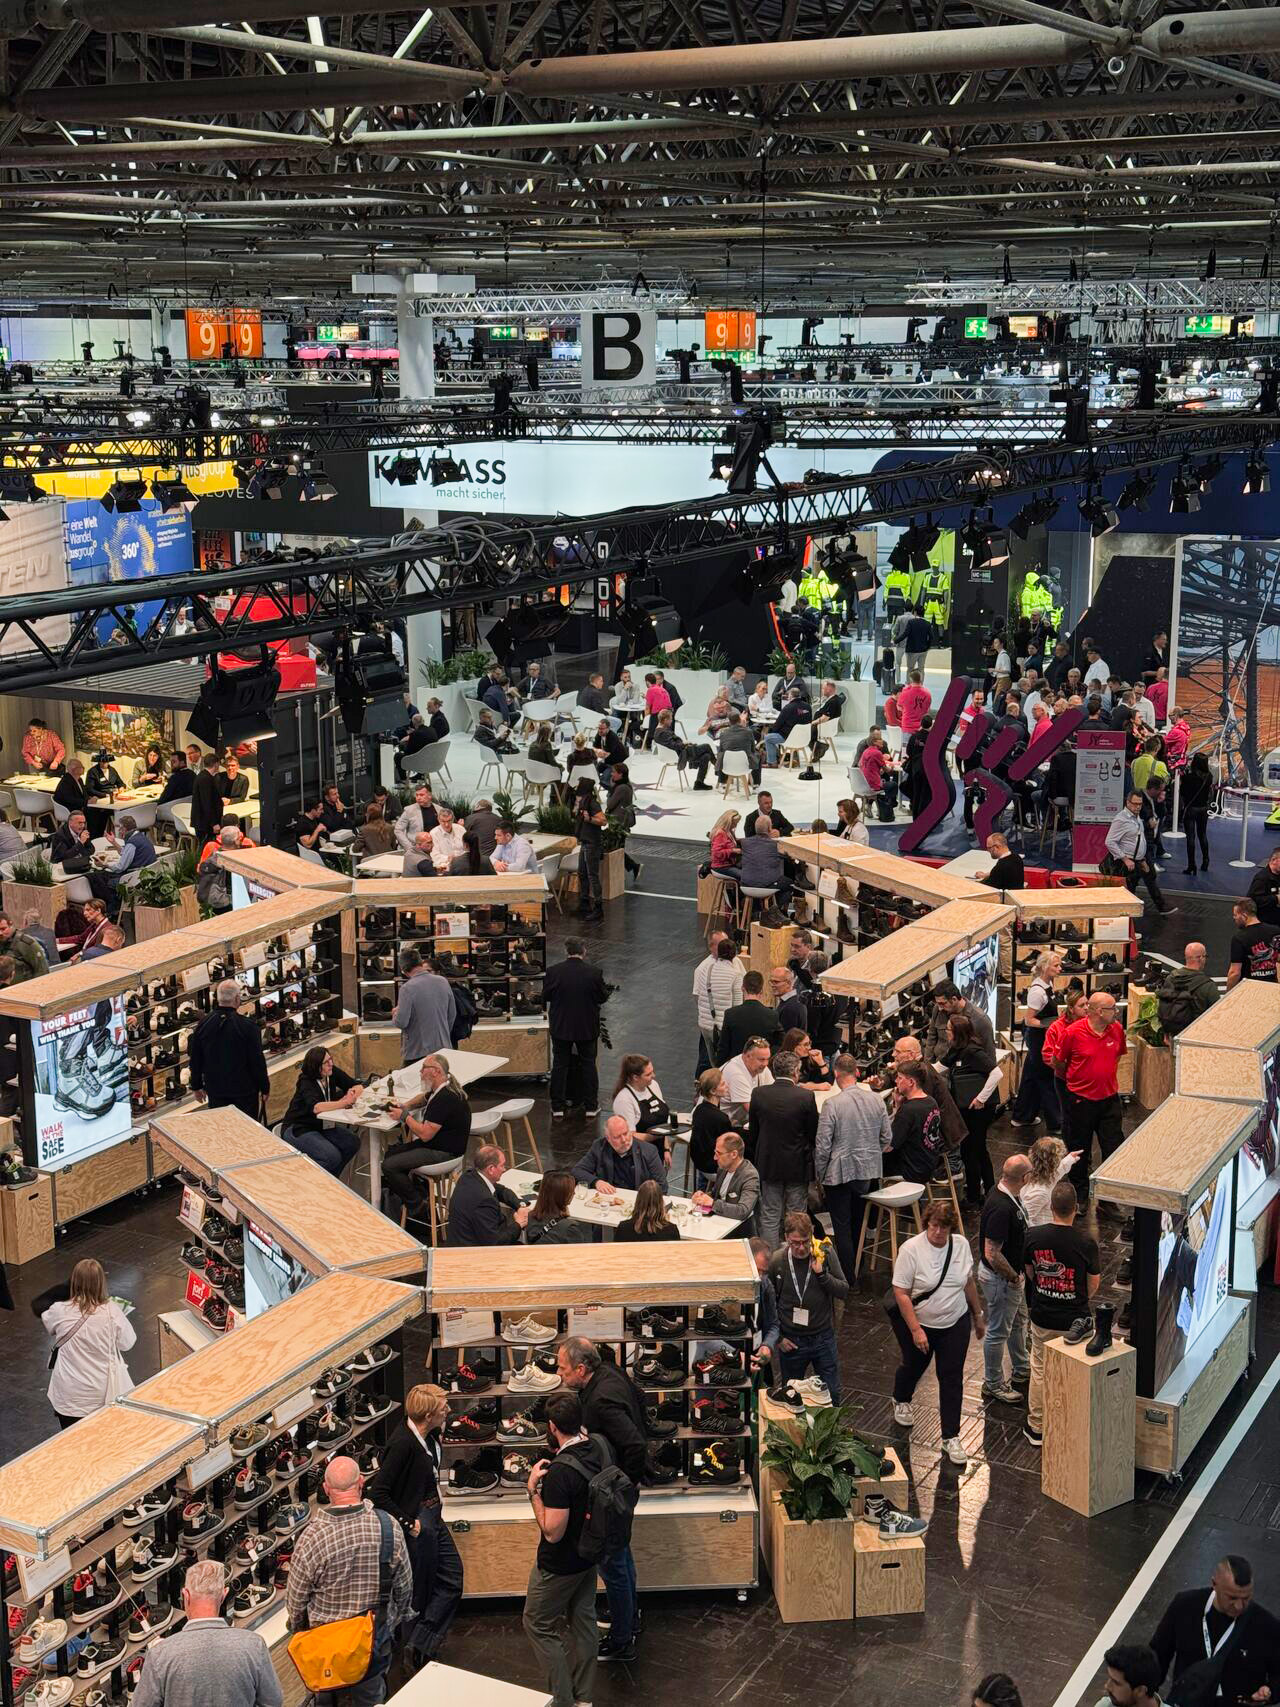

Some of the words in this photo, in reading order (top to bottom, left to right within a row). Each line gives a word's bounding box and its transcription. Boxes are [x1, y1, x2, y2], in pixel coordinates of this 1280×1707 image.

[200, 323, 216, 356] 9
[240, 323, 253, 356] 9
[592, 312, 644, 380] B
[716, 323, 728, 346] 9
[744, 323, 751, 345] 9
[374, 454, 506, 485] KMASS
[436, 486, 469, 498] macht
[472, 488, 507, 500] sicher.
[39, 1032, 57, 1046] WILL
[57, 1025, 80, 1040] THANK
[80, 1017, 96, 1030] YOU
[42, 1015, 68, 1032] YOUR
[68, 1008, 88, 1024] FEET
[41, 1121, 63, 1137] WALK
